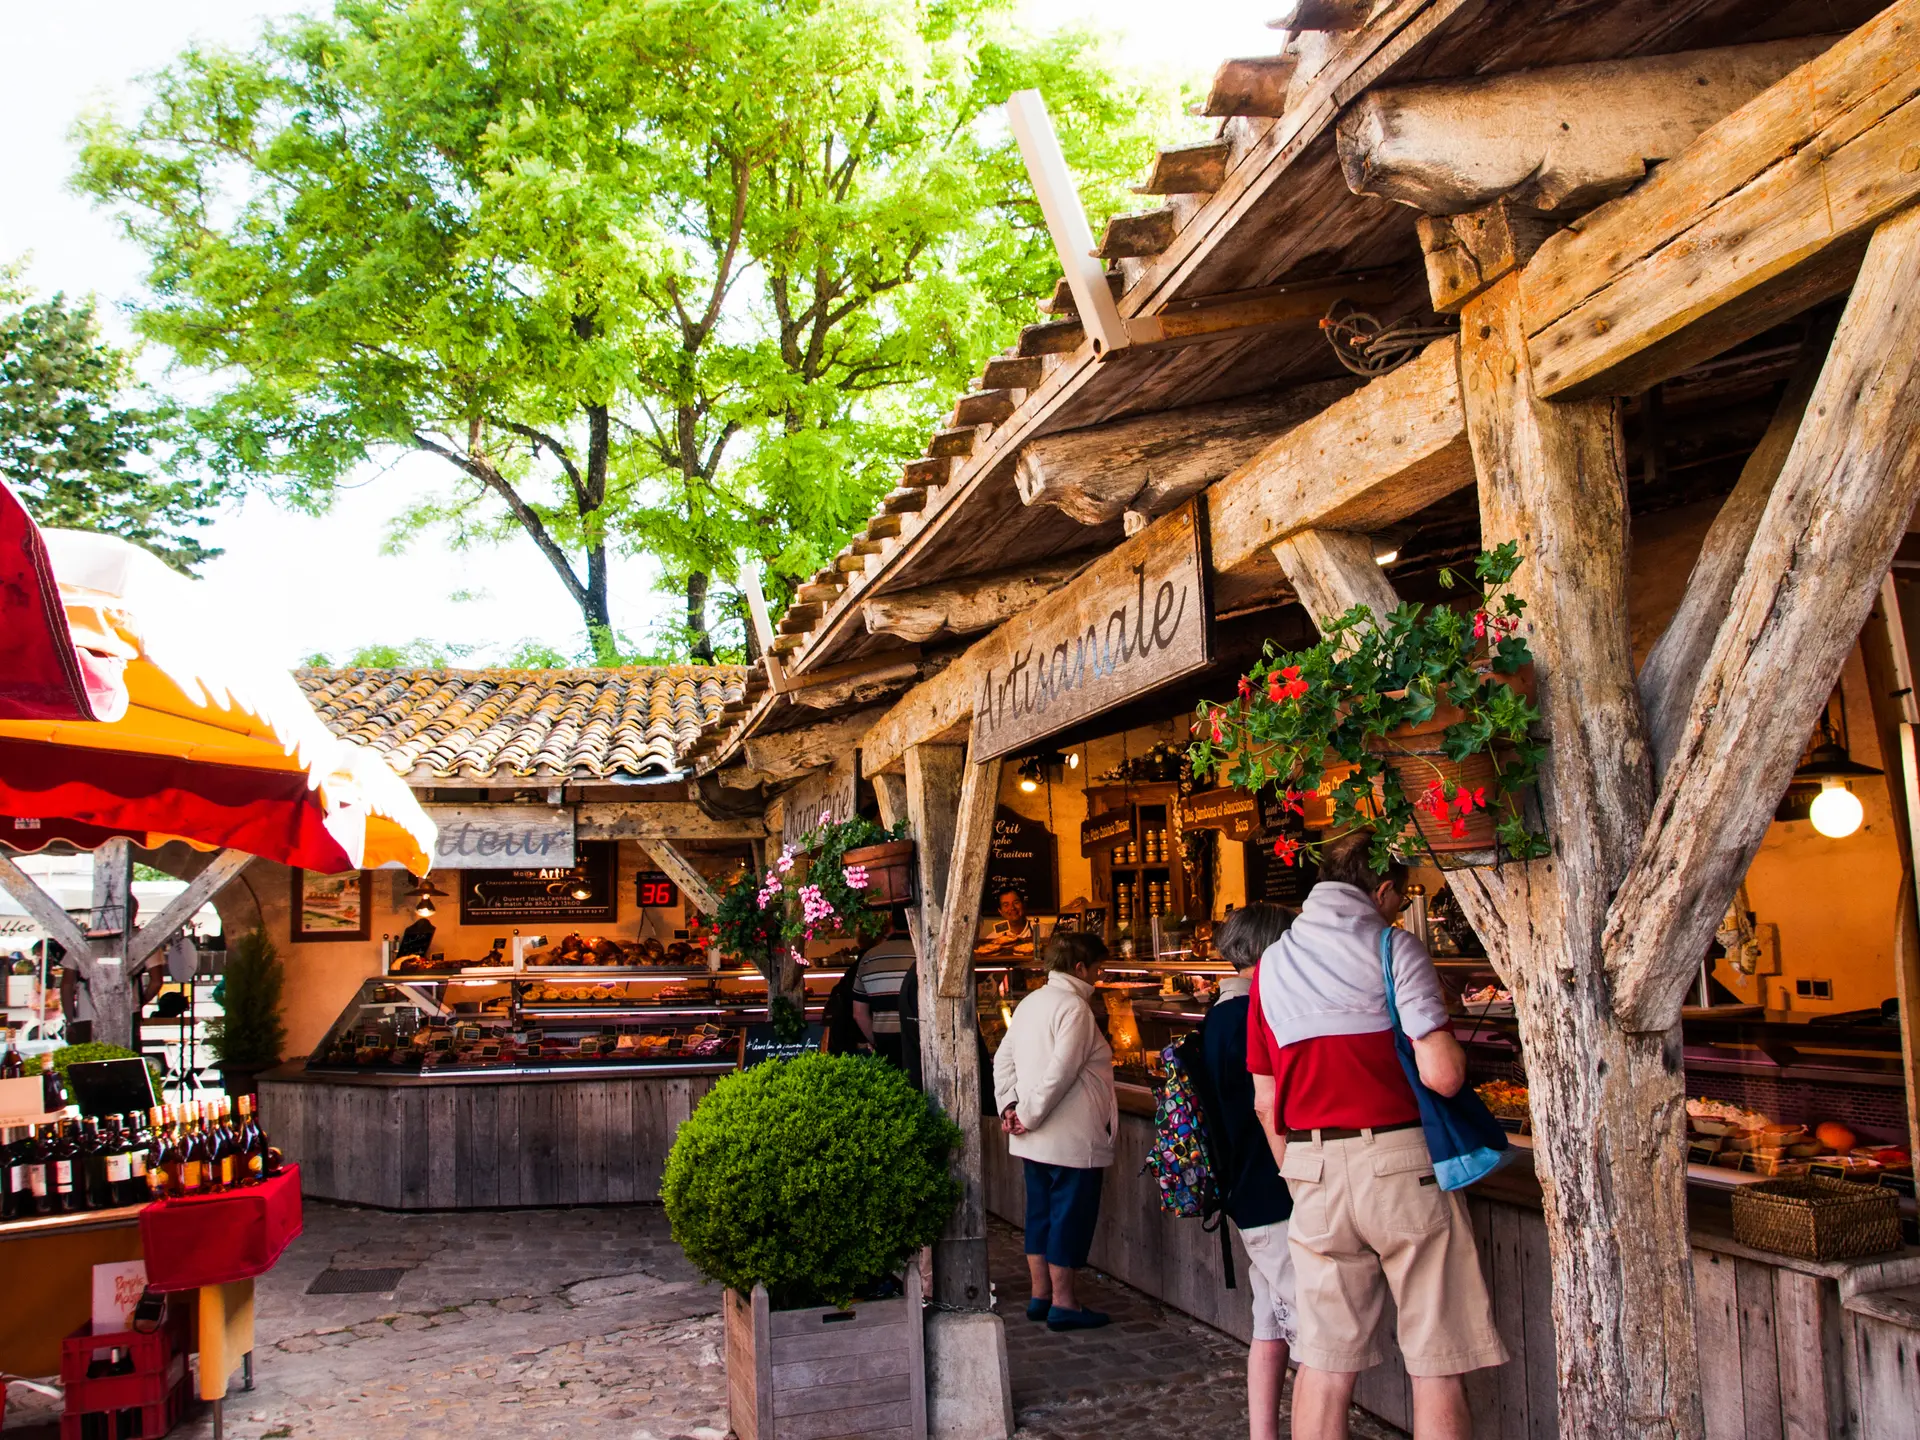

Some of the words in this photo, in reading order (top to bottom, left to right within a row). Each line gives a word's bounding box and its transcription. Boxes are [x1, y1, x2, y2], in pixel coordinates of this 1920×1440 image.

[977, 561, 1187, 739] Artisanale
[436, 822, 567, 857] iteur
[993, 848, 1034, 859] Traiteur
[642, 883, 670, 905] 36
[0, 920, 36, 937] ffee
